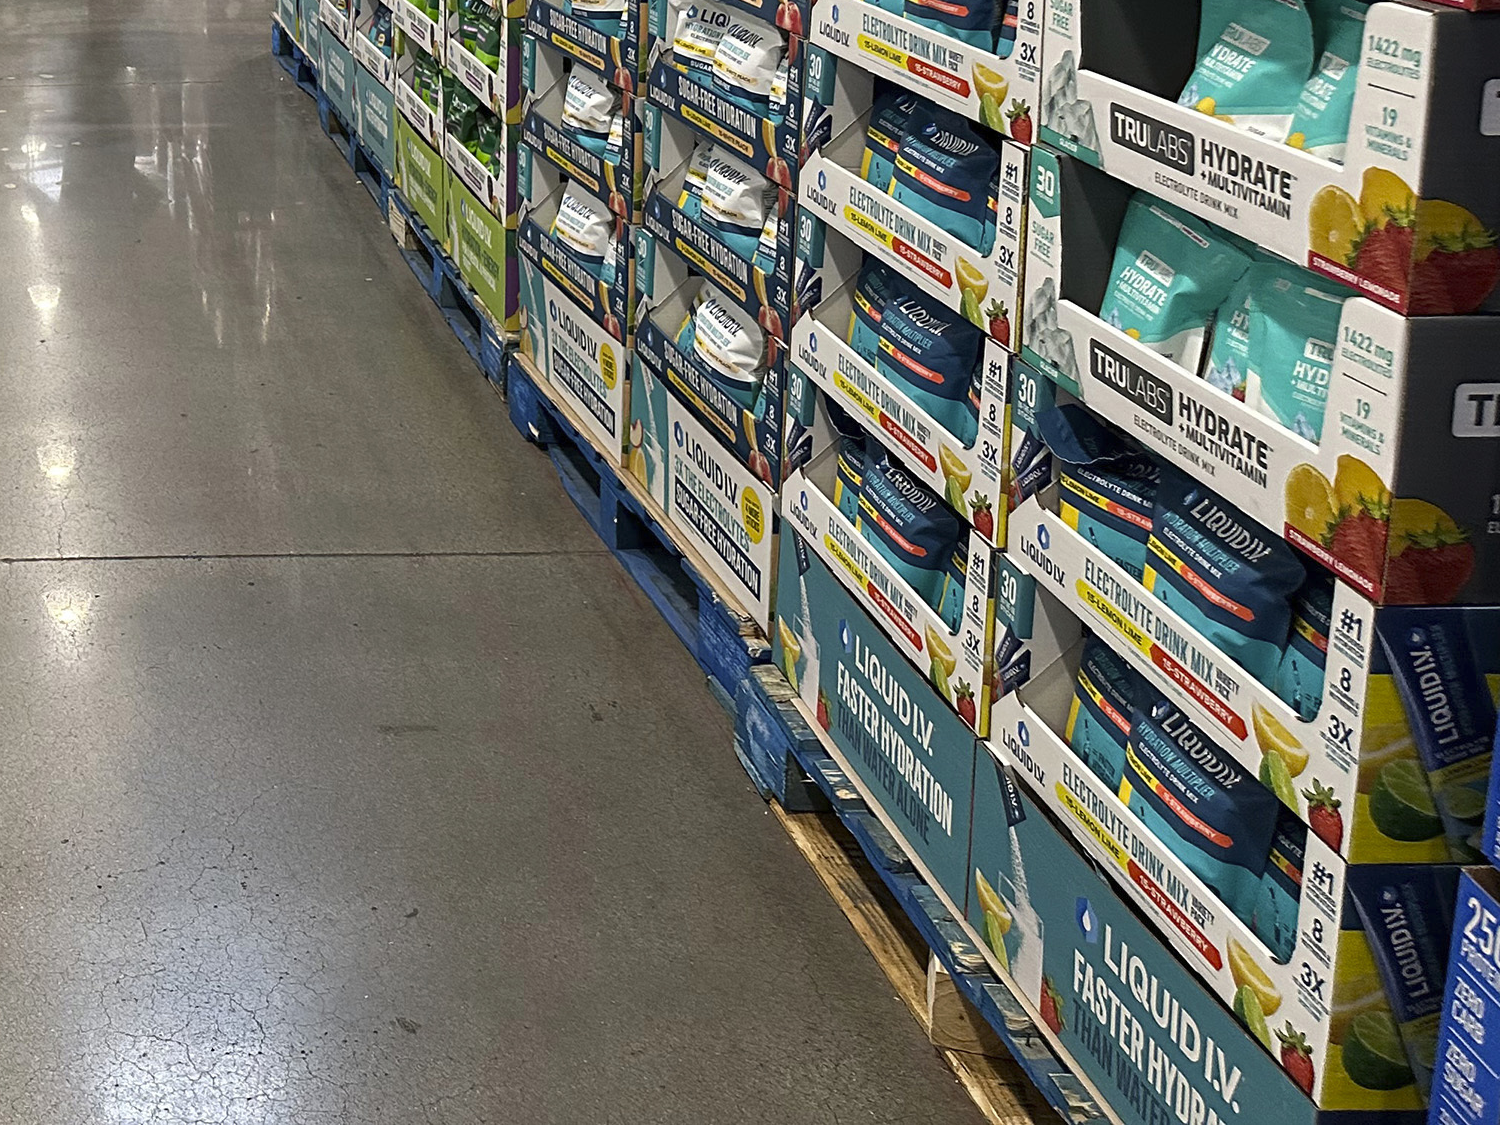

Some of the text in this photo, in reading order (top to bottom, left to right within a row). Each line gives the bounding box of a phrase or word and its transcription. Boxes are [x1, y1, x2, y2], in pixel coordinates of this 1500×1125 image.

[1114, 111, 1189, 167] TRULABS
[1200, 138, 1292, 200] HYDRATE
[1093, 347, 1168, 415] TRULABS
[684, 432, 725, 495] LIQUID
[1178, 393, 1270, 471] HYDRATE
[675, 484, 758, 593] SUGAR-FREE HYDRATION
[1020, 535, 1054, 578] LIQUID
[1084, 560, 1215, 684] ELECTROLYTE DRINK MIX
[1085, 591, 1143, 647] 15-LEMON LIME
[1341, 609, 1363, 641] #1
[854, 635, 934, 756] LIQUID I.V.
[1161, 658, 1234, 725] 15-STRAWBERRY
[1340, 668, 1353, 693] 8
[837, 661, 952, 837] FASTER HYDRATION
[1328, 715, 1354, 742] 3X
[1073, 950, 1145, 1066] FASTER
[1103, 924, 1242, 1114] LIQUID I.V.
